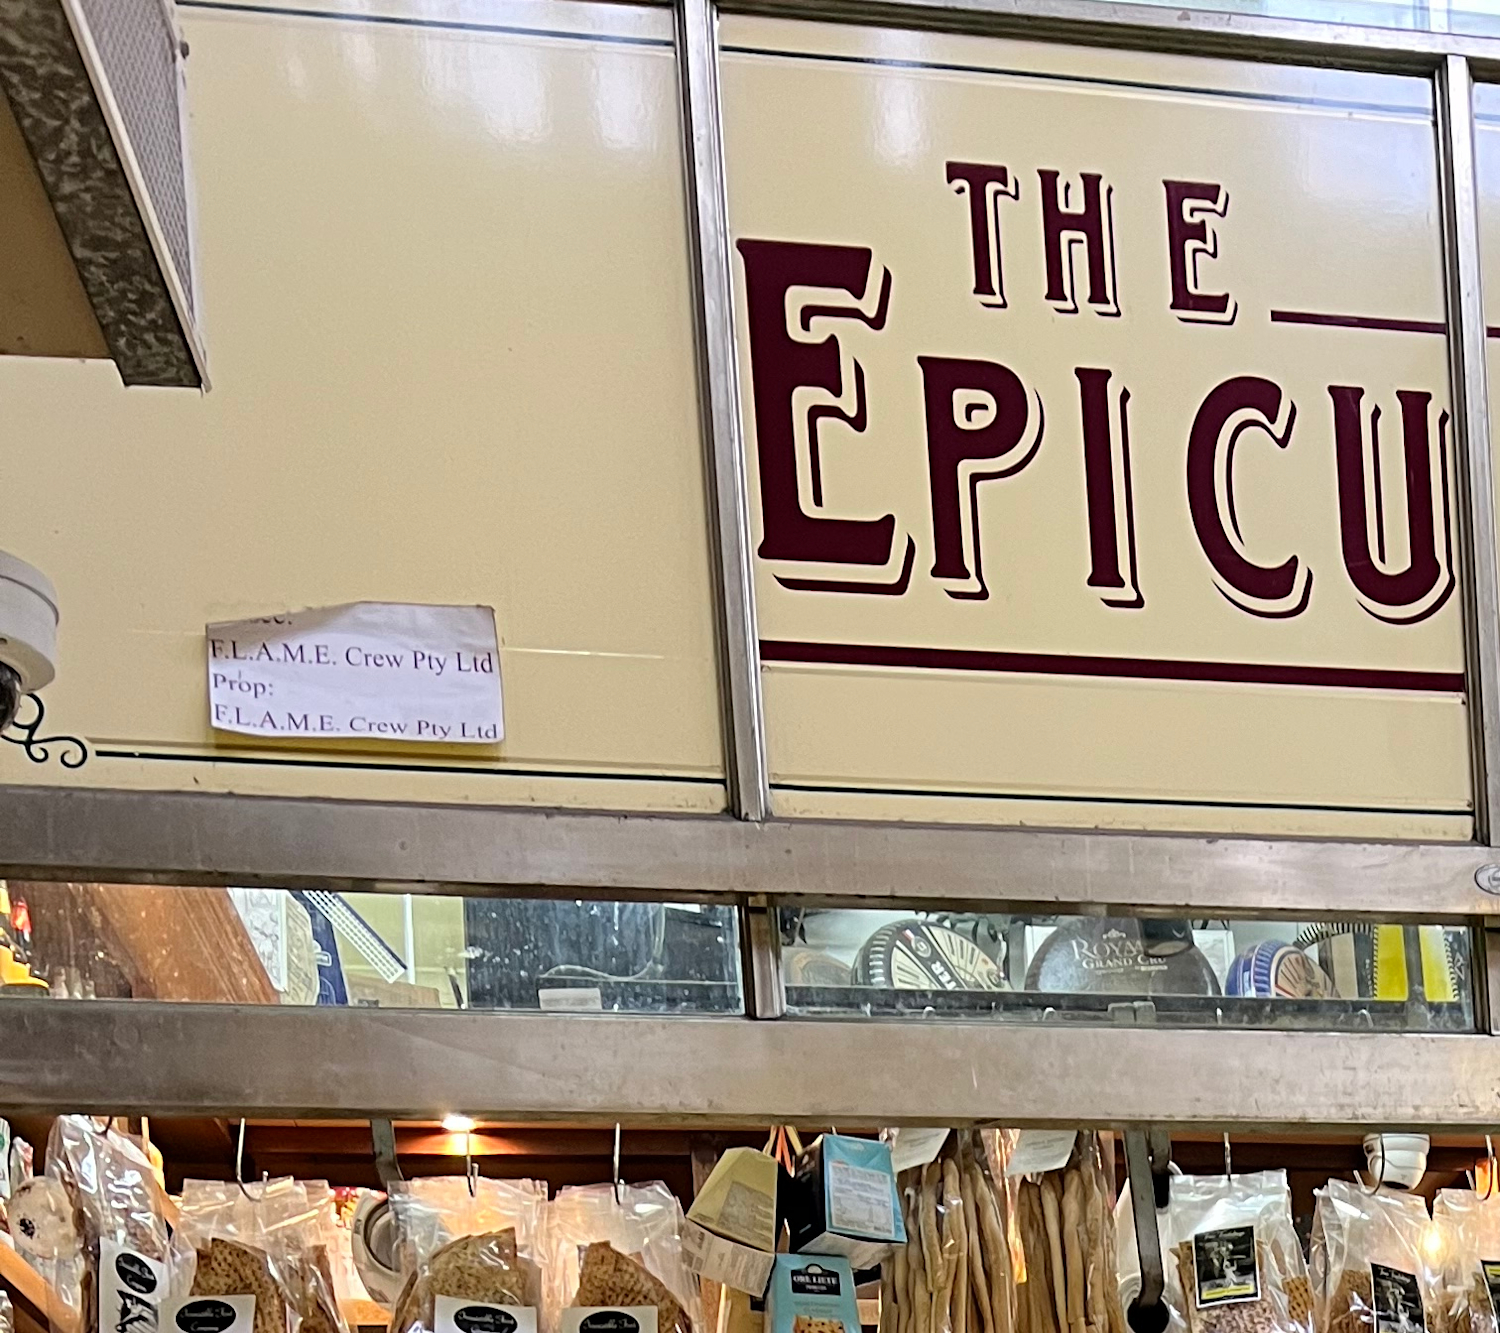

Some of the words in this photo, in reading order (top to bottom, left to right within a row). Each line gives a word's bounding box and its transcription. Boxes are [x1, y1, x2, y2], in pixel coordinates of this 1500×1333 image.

[946, 160, 1238, 324] THE
[210, 638, 337, 665] F.L.A.M.E.
[345, 646, 403, 668] Crew
[413, 650, 447, 675] Pty
[457, 652, 494, 673] Ltd
[212, 673, 274, 698] Prop:
[214, 704, 340, 732] F.L.A.M.E.
[349, 717, 408, 735] Crew
[417, 720, 451, 739] Pty
[460, 723, 498, 739] Ltd
